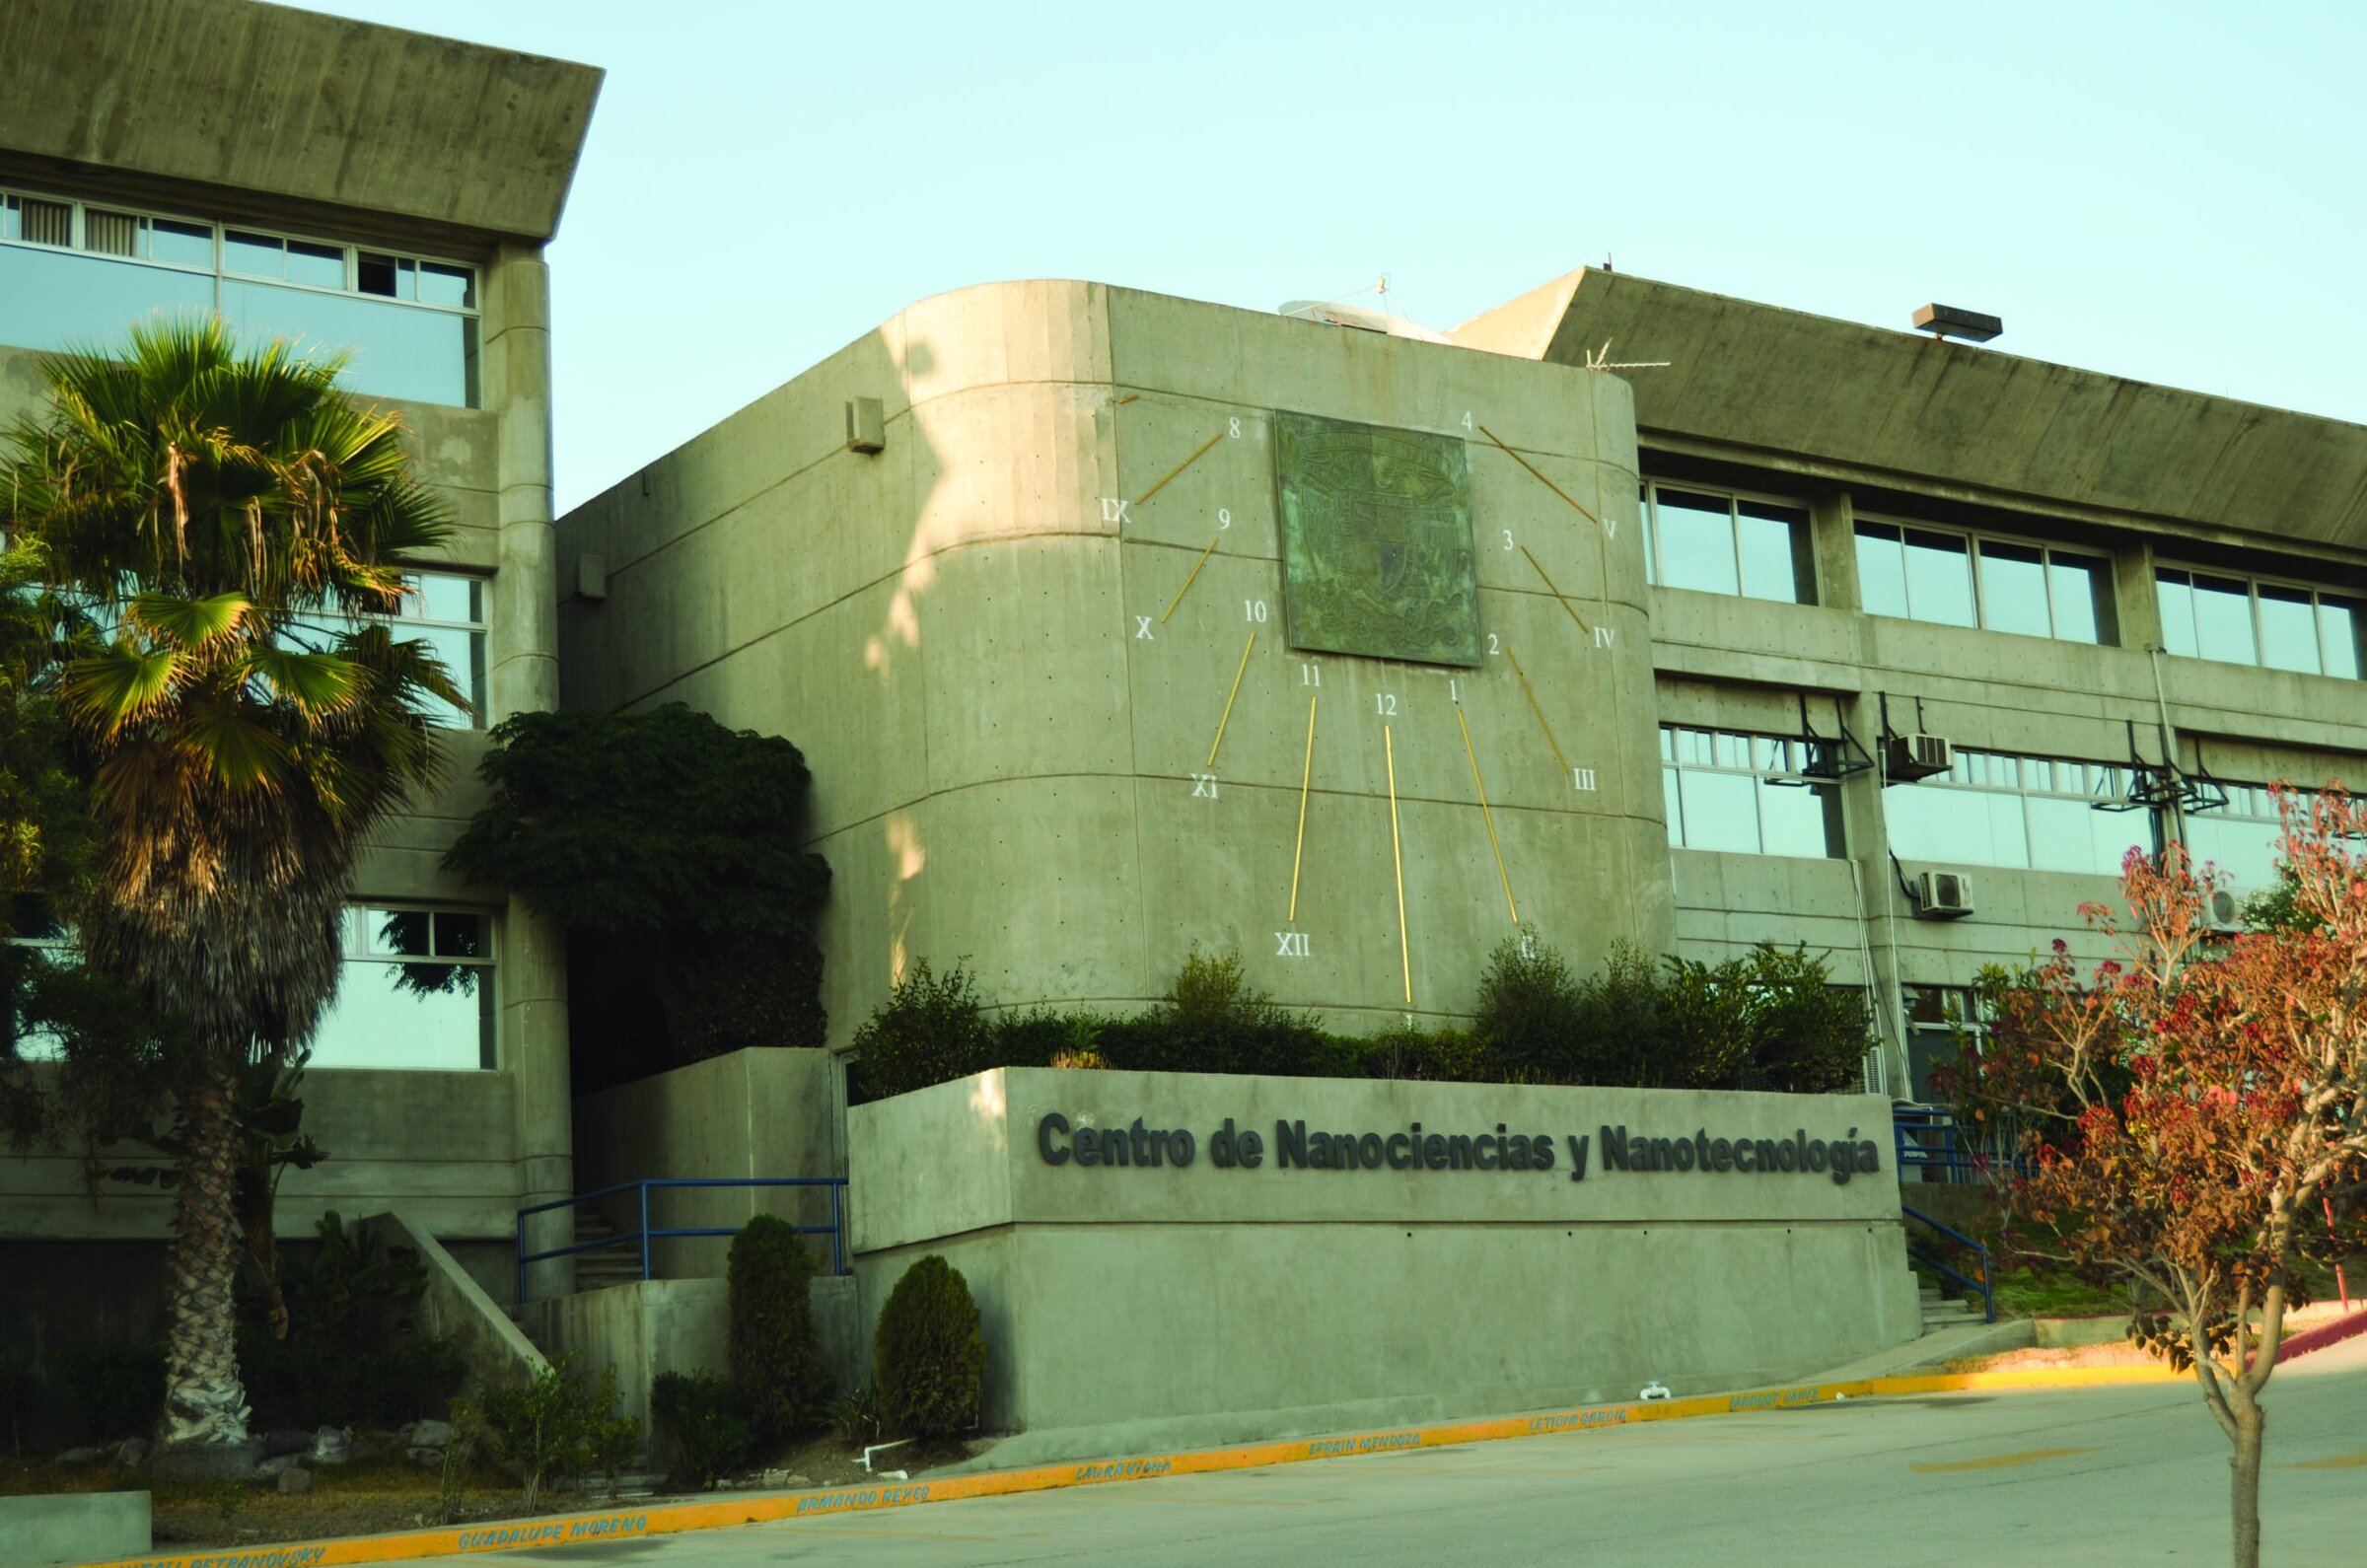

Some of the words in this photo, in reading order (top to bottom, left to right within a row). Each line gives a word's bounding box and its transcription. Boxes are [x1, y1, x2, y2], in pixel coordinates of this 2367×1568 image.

[1229, 416, 1241, 439] 8
[1462, 410, 1472, 432] 4
[1101, 497, 1131, 524] IX
[1218, 508, 1231, 531] 9
[1502, 529, 1514, 551] 3
[1603, 519, 1617, 539] V
[1244, 599, 1268, 623] 10
[1135, 615, 1154, 640] X
[1593, 625, 1615, 650] IV
[1487, 633, 1500, 656] 2
[1301, 663, 1321, 687] 11
[1449, 678, 1458, 702] 1
[1376, 693, 1398, 716] 12
[1189, 773, 1219, 799] XI
[1572, 767, 1598, 791] III
[1273, 932, 1312, 957] XII
[1039, 1111, 1196, 1168] Centro
[1210, 1117, 1264, 1169] de
[1276, 1118, 1555, 1172] Nanociencias
[1567, 1134, 1590, 1181] y
[1601, 1124, 1881, 1185] Nanotecnología
[1309, 1440, 1356, 1455] EFRAIN
[1359, 1433, 1421, 1451] MENDOZA
[797, 1490, 878, 1513] ARMANDO
[882, 1485, 931, 1503] REYES
[458, 1524, 565, 1550] GUADALUPE
[570, 1515, 647, 1537] MORENO
